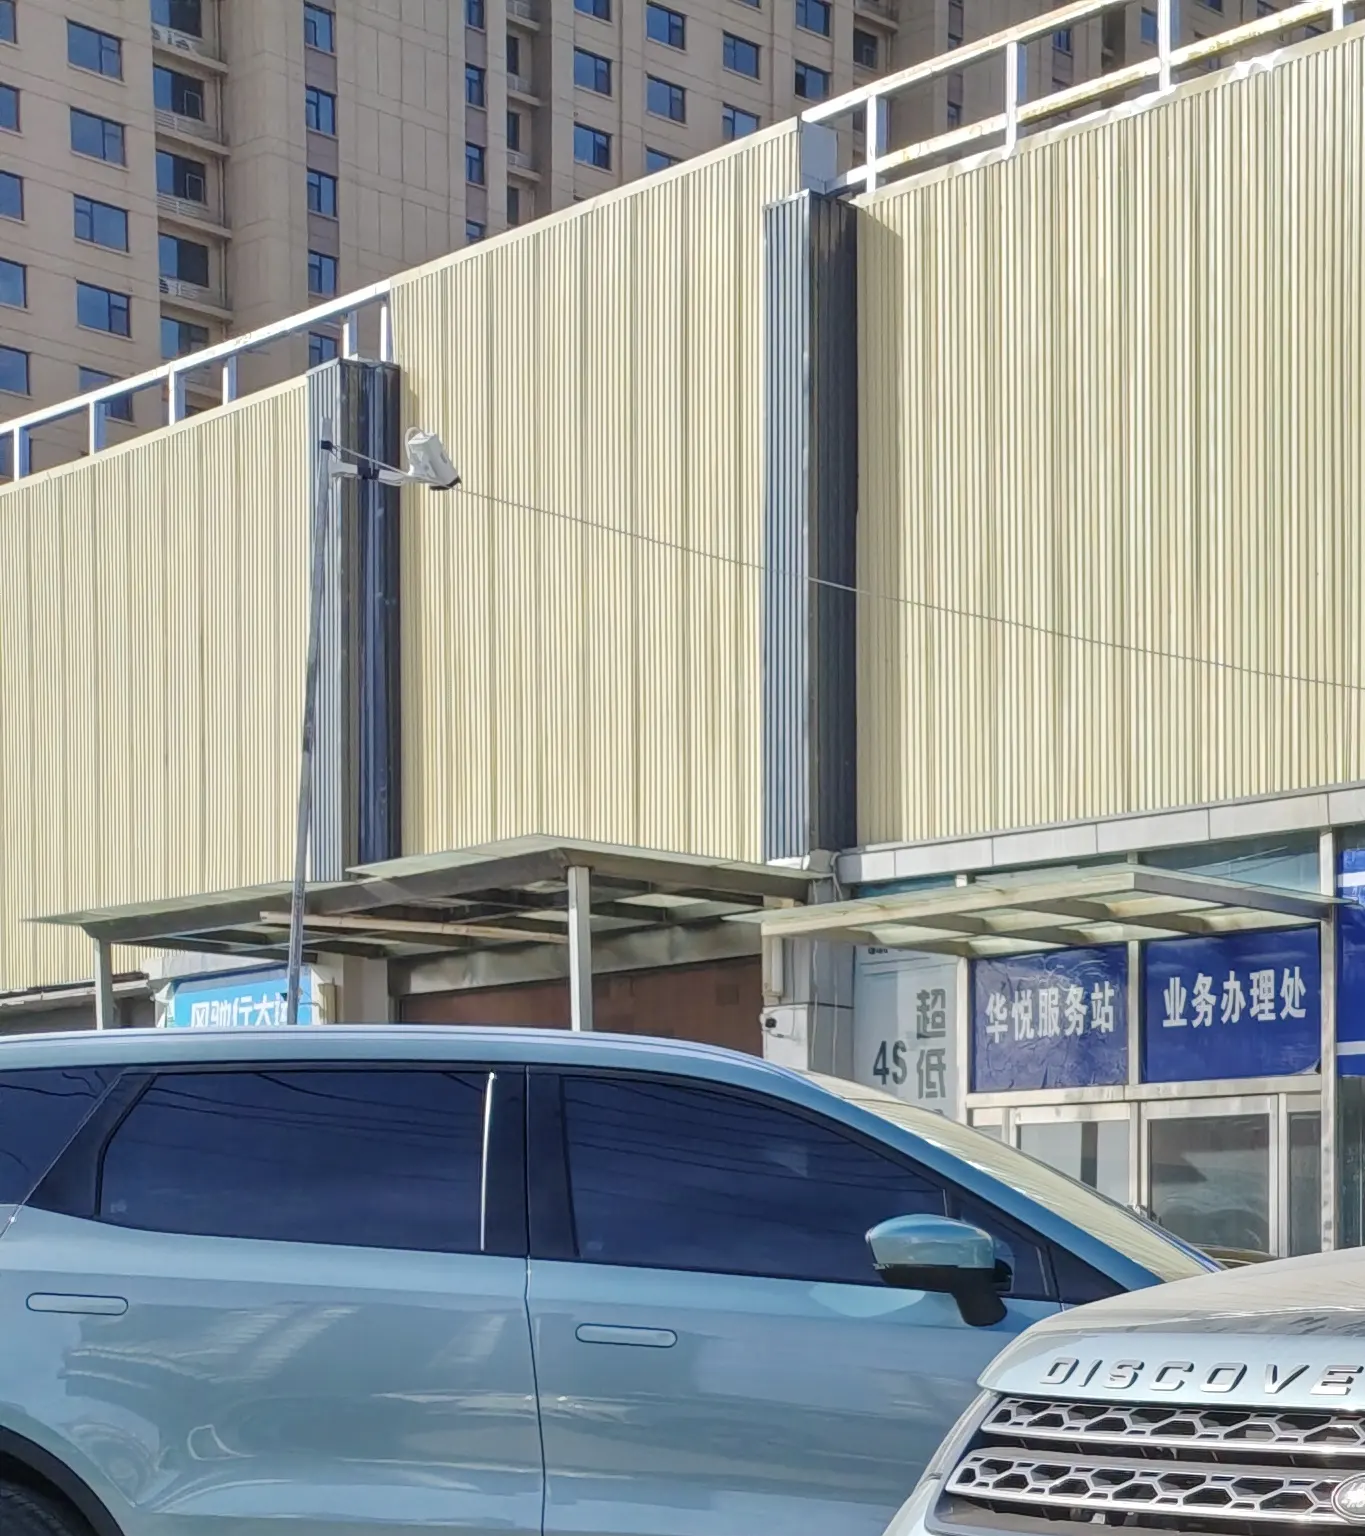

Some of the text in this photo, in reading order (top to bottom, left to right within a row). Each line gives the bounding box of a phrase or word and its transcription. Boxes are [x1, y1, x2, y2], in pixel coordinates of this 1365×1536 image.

[985, 981, 1115, 1044] 华悦服务站
[1162, 966, 1307, 1029] 业务办理处
[873, 1040, 908, 1085] 4S
[916, 988, 946, 1116] 超低
